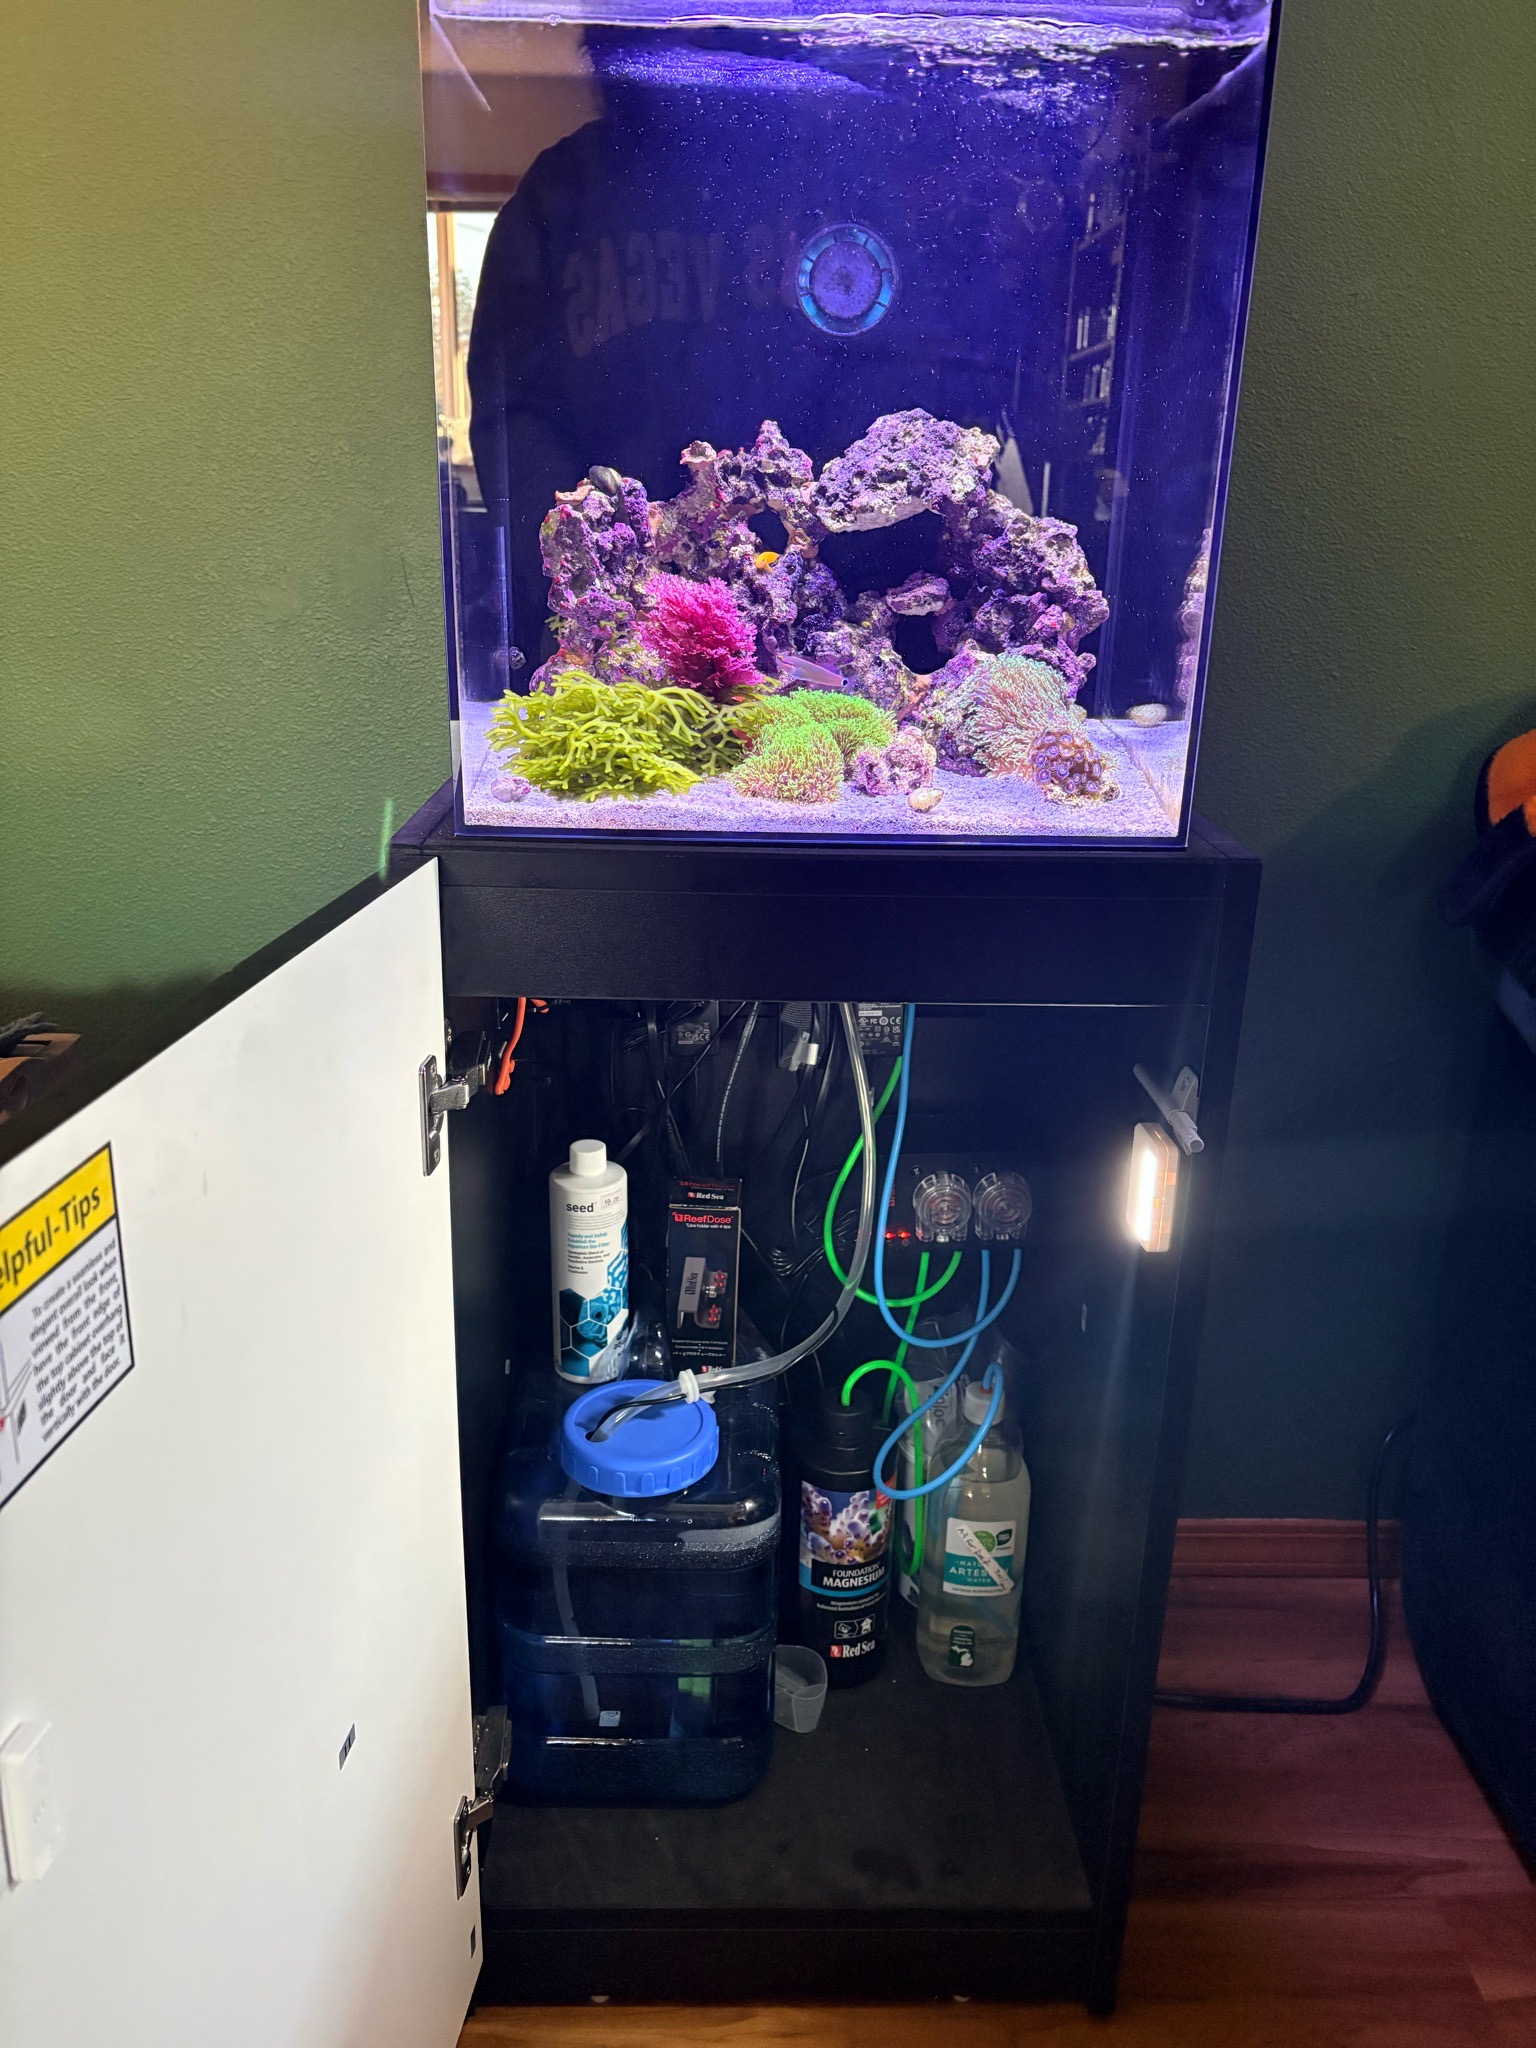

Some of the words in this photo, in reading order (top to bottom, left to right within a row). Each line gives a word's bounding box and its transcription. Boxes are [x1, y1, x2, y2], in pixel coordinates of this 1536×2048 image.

[684, 1214, 731, 1223] ReefDose
[823, 1566, 885, 1588] MAGNESIUM
[833, 1563, 879, 1577] FOUNDATION
[840, 1643, 861, 1658] Red
[861, 1640, 875, 1654] Sea
